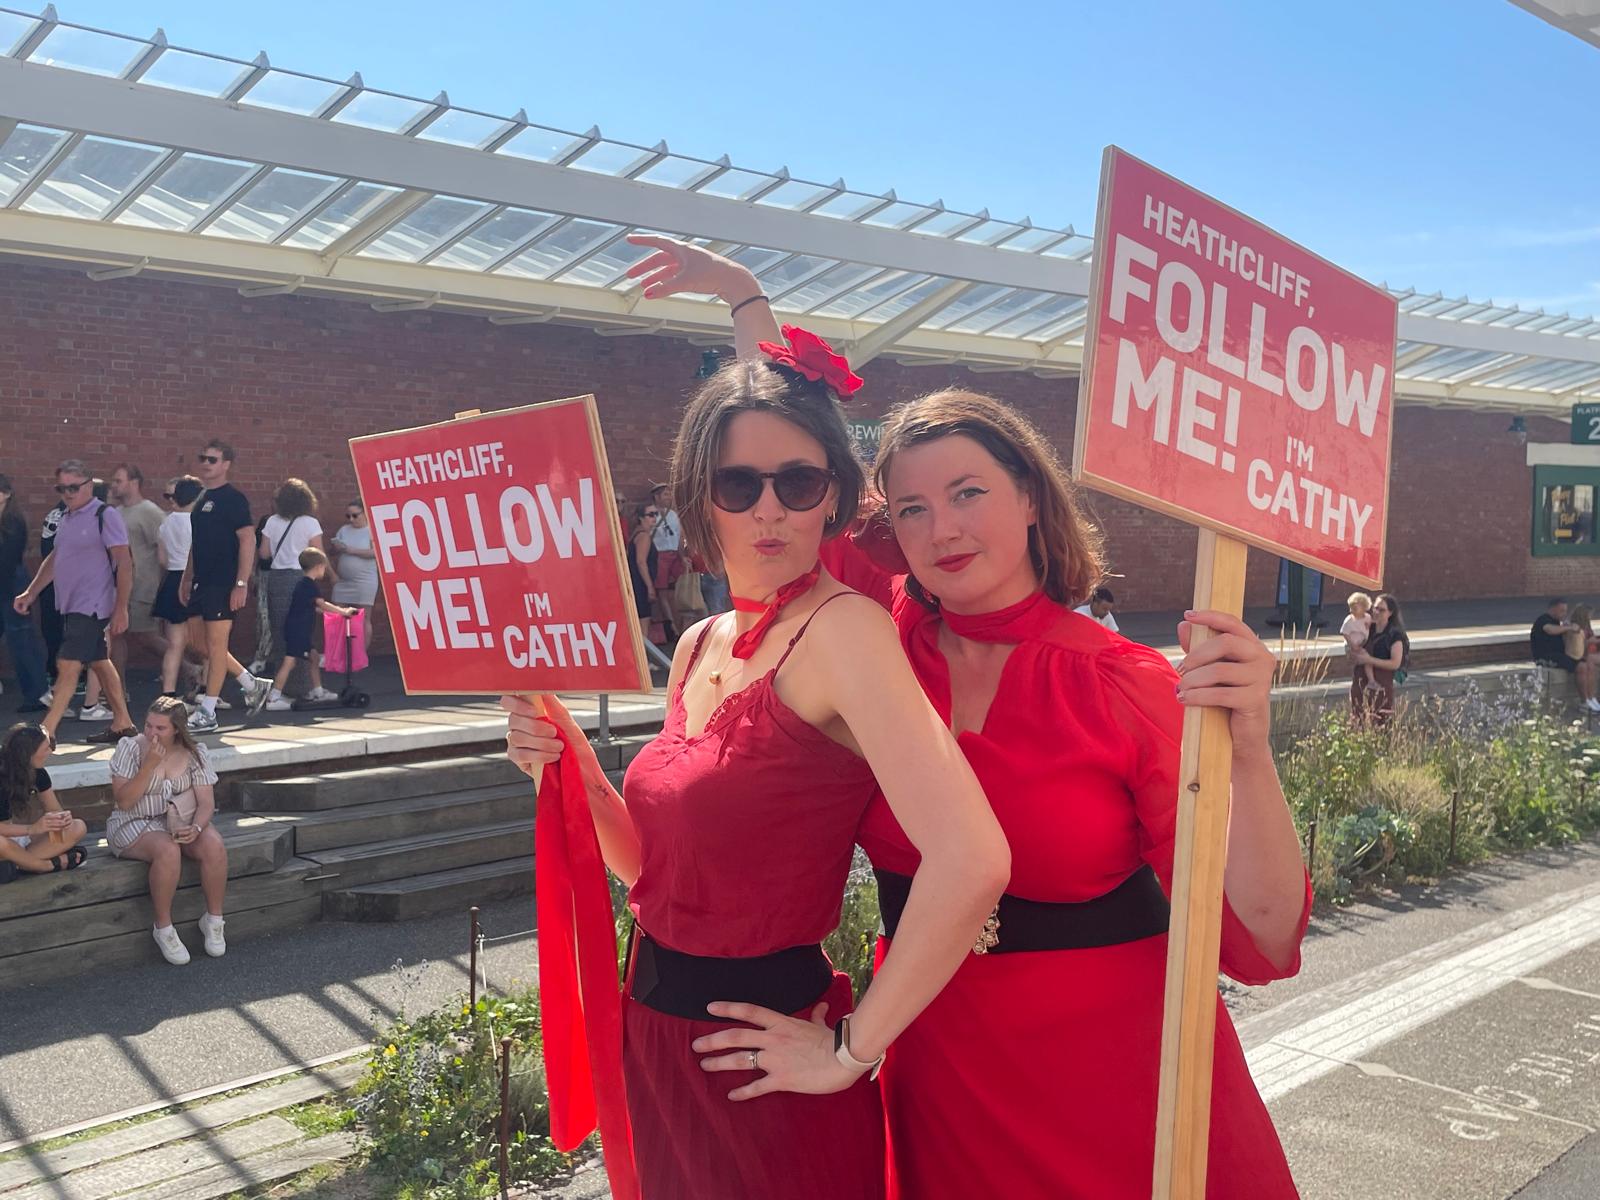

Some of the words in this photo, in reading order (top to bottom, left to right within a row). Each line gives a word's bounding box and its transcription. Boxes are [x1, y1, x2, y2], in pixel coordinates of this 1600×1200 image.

[1143, 195, 1315, 319] HEATHCLIFF,
[1109, 233, 1386, 437] FOLLOW
[1111, 338, 1242, 473] ME!
[1588, 417, 1600, 440] 2
[376, 441, 513, 490] HEATHCLIFF,
[1286, 436, 1315, 472] I'M
[370, 478, 597, 573] FOLLOW
[1247, 458, 1373, 548] CATHY
[396, 577, 494, 649] ME!
[523, 592, 552, 618] I'M
[503, 621, 617, 668] CATHY
[1434, 1084, 1541, 1141] GAP
